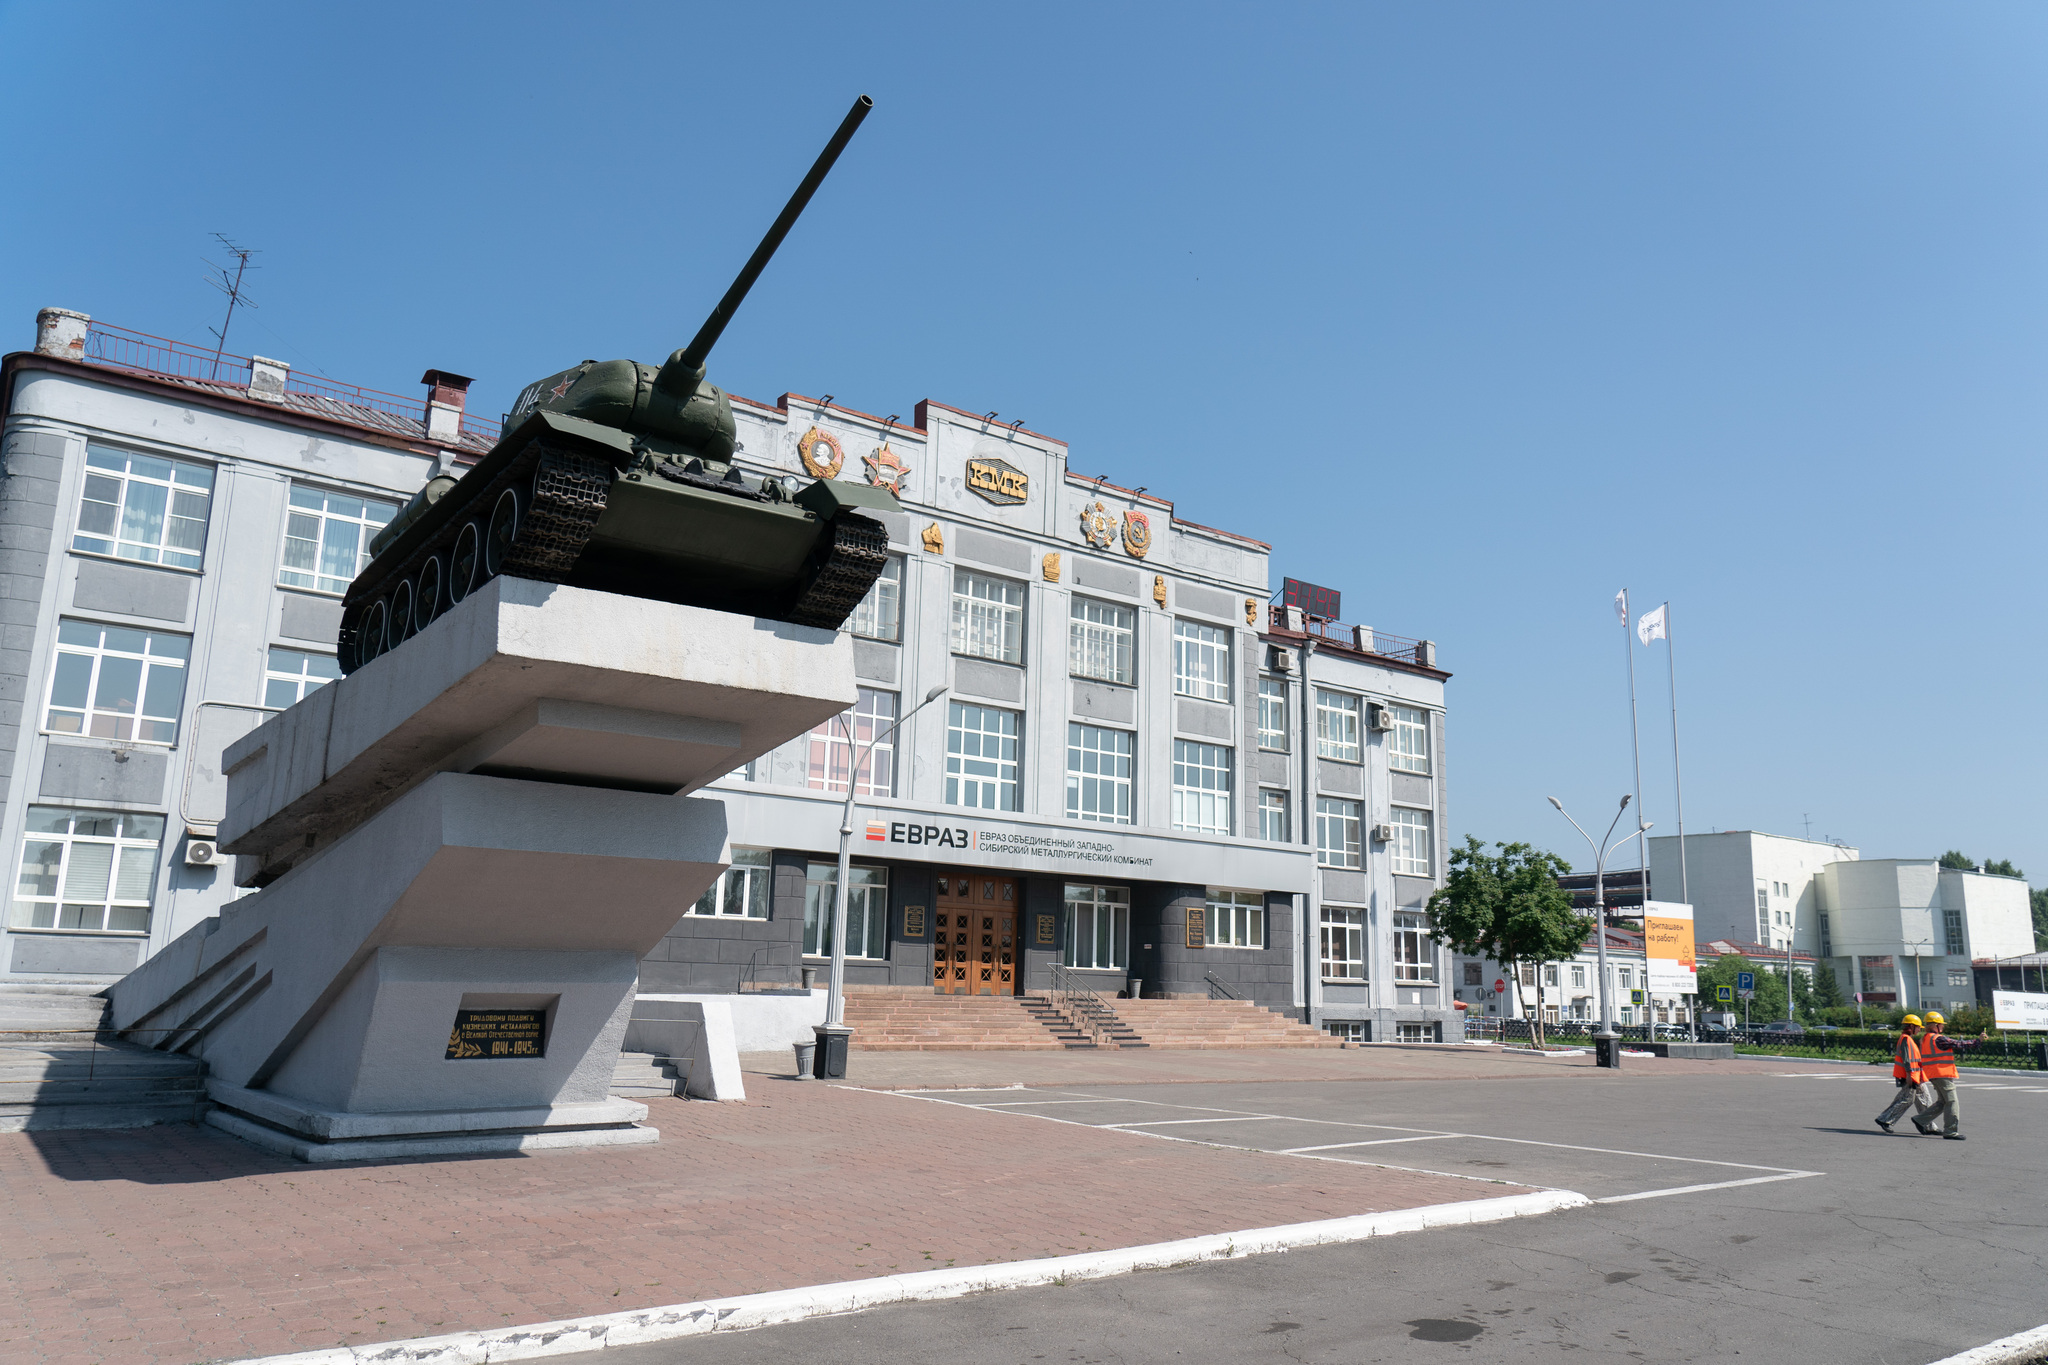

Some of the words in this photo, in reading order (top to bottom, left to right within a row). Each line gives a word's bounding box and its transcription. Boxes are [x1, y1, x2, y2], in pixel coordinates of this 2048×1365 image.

[970, 461, 1027, 499] КМК
[890, 821, 969, 849] ЕВРАЗ
[980, 831, 1007, 842] ЕВРАЗ
[1007, 834, 1075, 849] ОБЪЕДИНЕННЫЙ
[1076, 840, 1115, 853] ЗАПАДНО-
[979, 842, 1029, 856] СИБИРСКИЙ
[1030, 847, 1112, 863] МЕТАЛЛУРГИЧЕСКИЙ
[1113, 855, 1153, 867] КОМБИНАТ
[1647, 919, 1685, 931] Приглашаем
[1647, 934, 1656, 942] на
[1656, 933, 1680, 945] работу!
[1741, 974, 1751, 987] P
[469, 1014, 506, 1022] ТРУДОВОМУ
[507, 1014, 535, 1022] ПОДВИГУ
